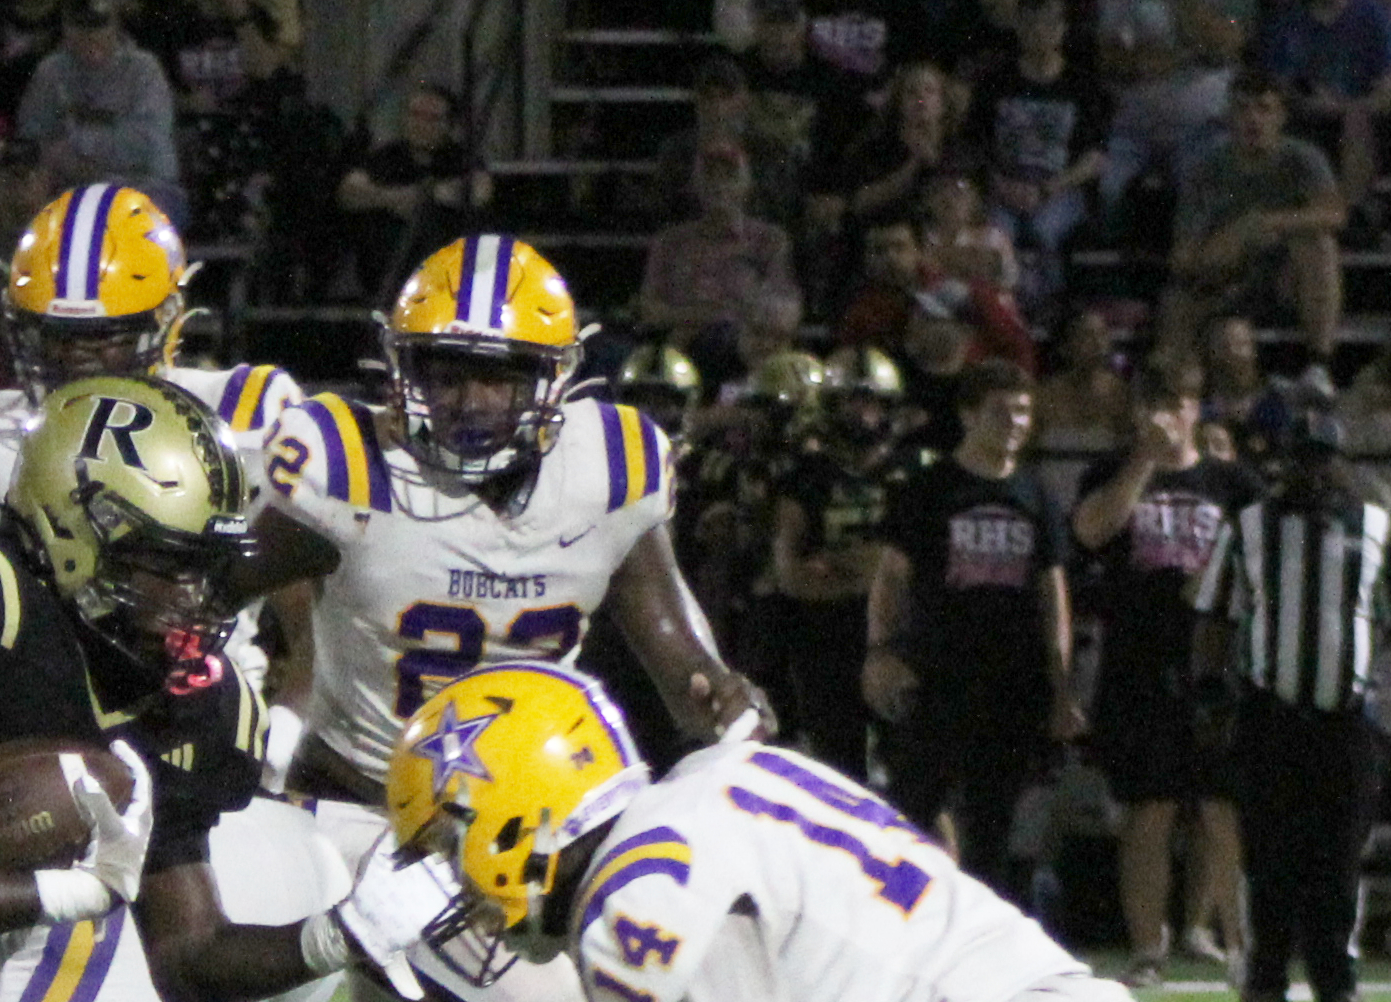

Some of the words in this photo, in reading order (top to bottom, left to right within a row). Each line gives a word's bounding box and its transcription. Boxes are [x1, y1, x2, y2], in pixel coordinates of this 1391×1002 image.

[69, 394, 157, 472] R
[950, 518, 1034, 555] RHS
[448, 567, 546, 599] BOBCATS
